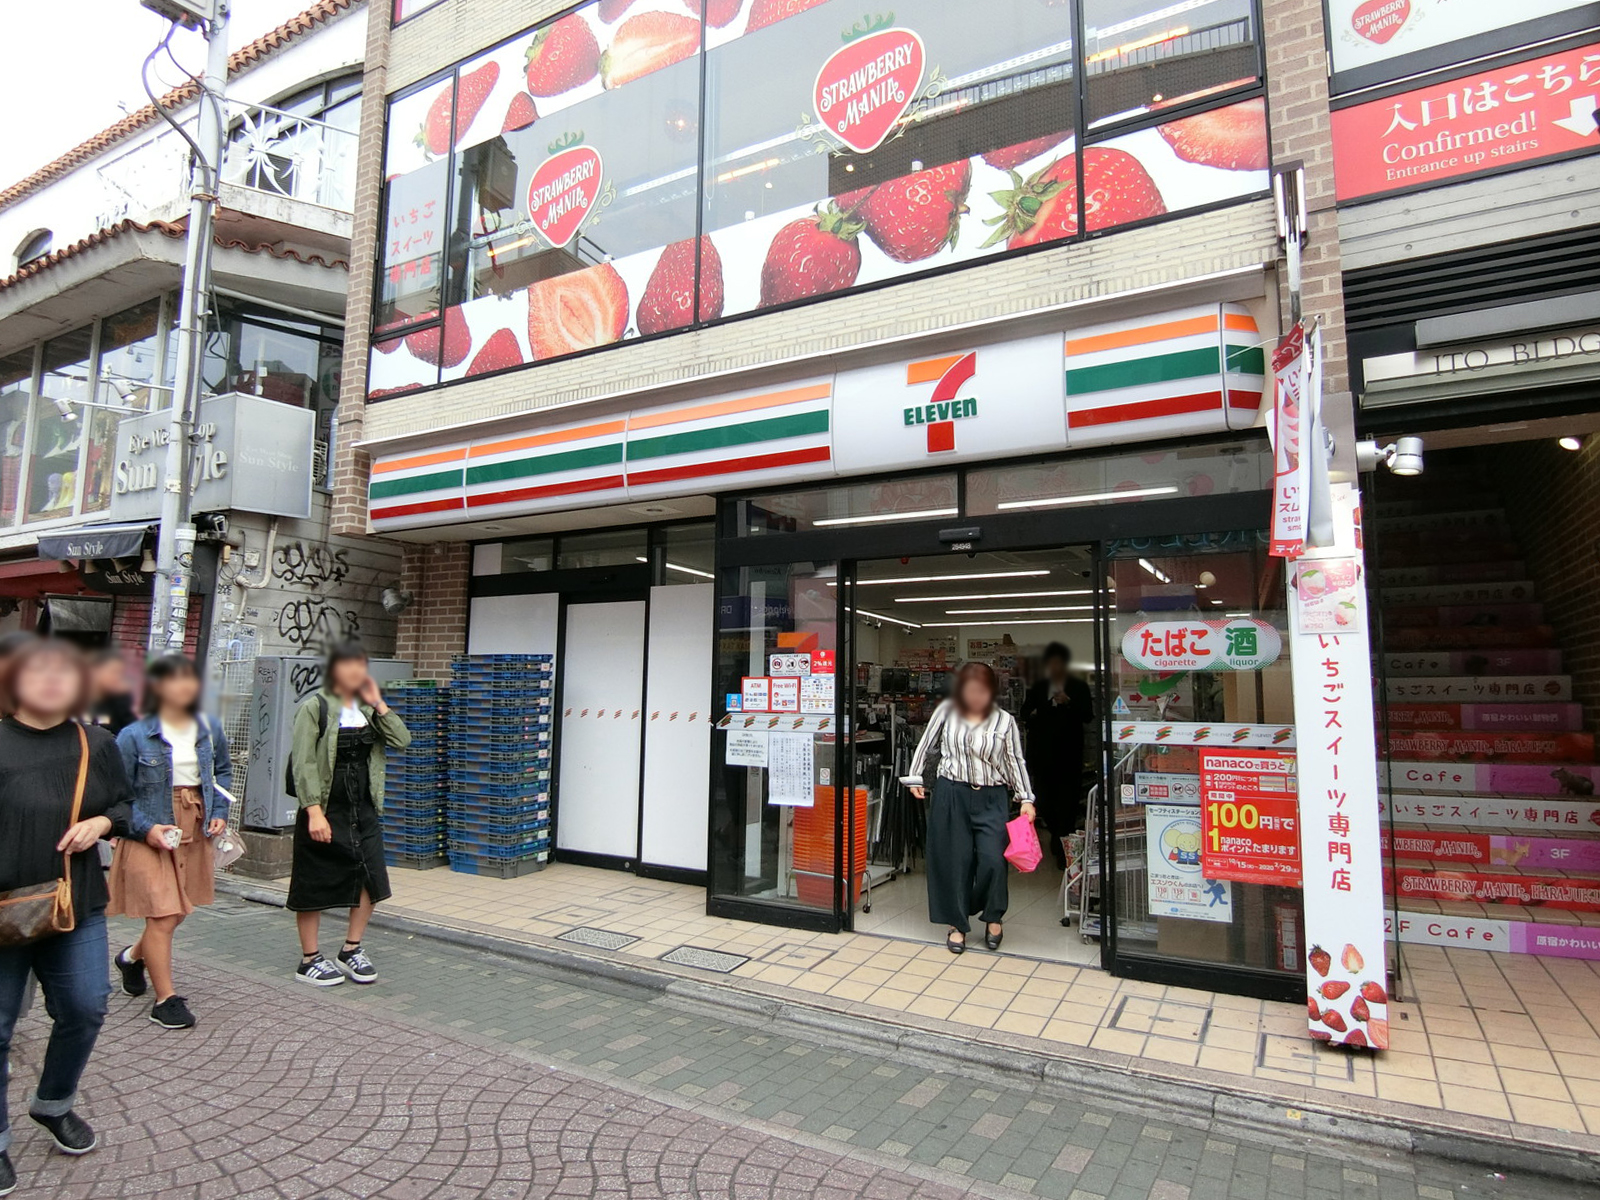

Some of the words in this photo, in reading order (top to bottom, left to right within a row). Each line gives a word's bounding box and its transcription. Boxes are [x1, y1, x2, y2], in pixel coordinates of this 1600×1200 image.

[820, 41, 914, 112] STRAWBERRY
[838, 77, 905, 133] MANIA
[1381, 54, 1600, 138] 入口はこちら
[1382, 110, 1537, 164] Confirmed!
[1386, 155, 1458, 181] Entrance
[1464, 149, 1485, 165] up
[1490, 139, 1538, 157] stairs
[531, 157, 596, 212] STRAWBERRY
[394, 200, 437, 228] いちご
[542, 186, 588, 230] MANIA
[391, 230, 435, 256] スイーツ
[1433, 350, 1489, 377] ITO
[129, 434, 149, 454] Eye
[239, 451, 264, 466] Sun
[267, 458, 299, 473] Style
[115, 459, 157, 494] Sun
[67, 543, 81, 556] Sun
[84, 541, 103, 557] Style
[105, 572, 123, 584] Sun
[123, 571, 145, 586] Style
[1141, 627, 1210, 657] たばこ
[1225, 627, 1257, 656] 酒
[1154, 659, 1196, 667] cigarette
[1229, 659, 1259, 667] liquor
[1391, 658, 1439, 669] Cafe
[1318, 634, 1352, 892] いちごスイーツ専門店
[1406, 770, 1462, 782] Cafe
[1395, 804, 1579, 824] いちごスイーツ専門店
[1208, 828, 1219, 851] 1
[1220, 836, 1251, 845] nanaco
[1434, 841, 1482, 858] MANIA
[1551, 849, 1570, 859] 3F
[1402, 876, 1477, 894] STRAWBERRY
[1476, 883, 1530, 901] MANIA
[1384, 918, 1410, 933] 2F
[1428, 924, 1493, 941] Cafe
